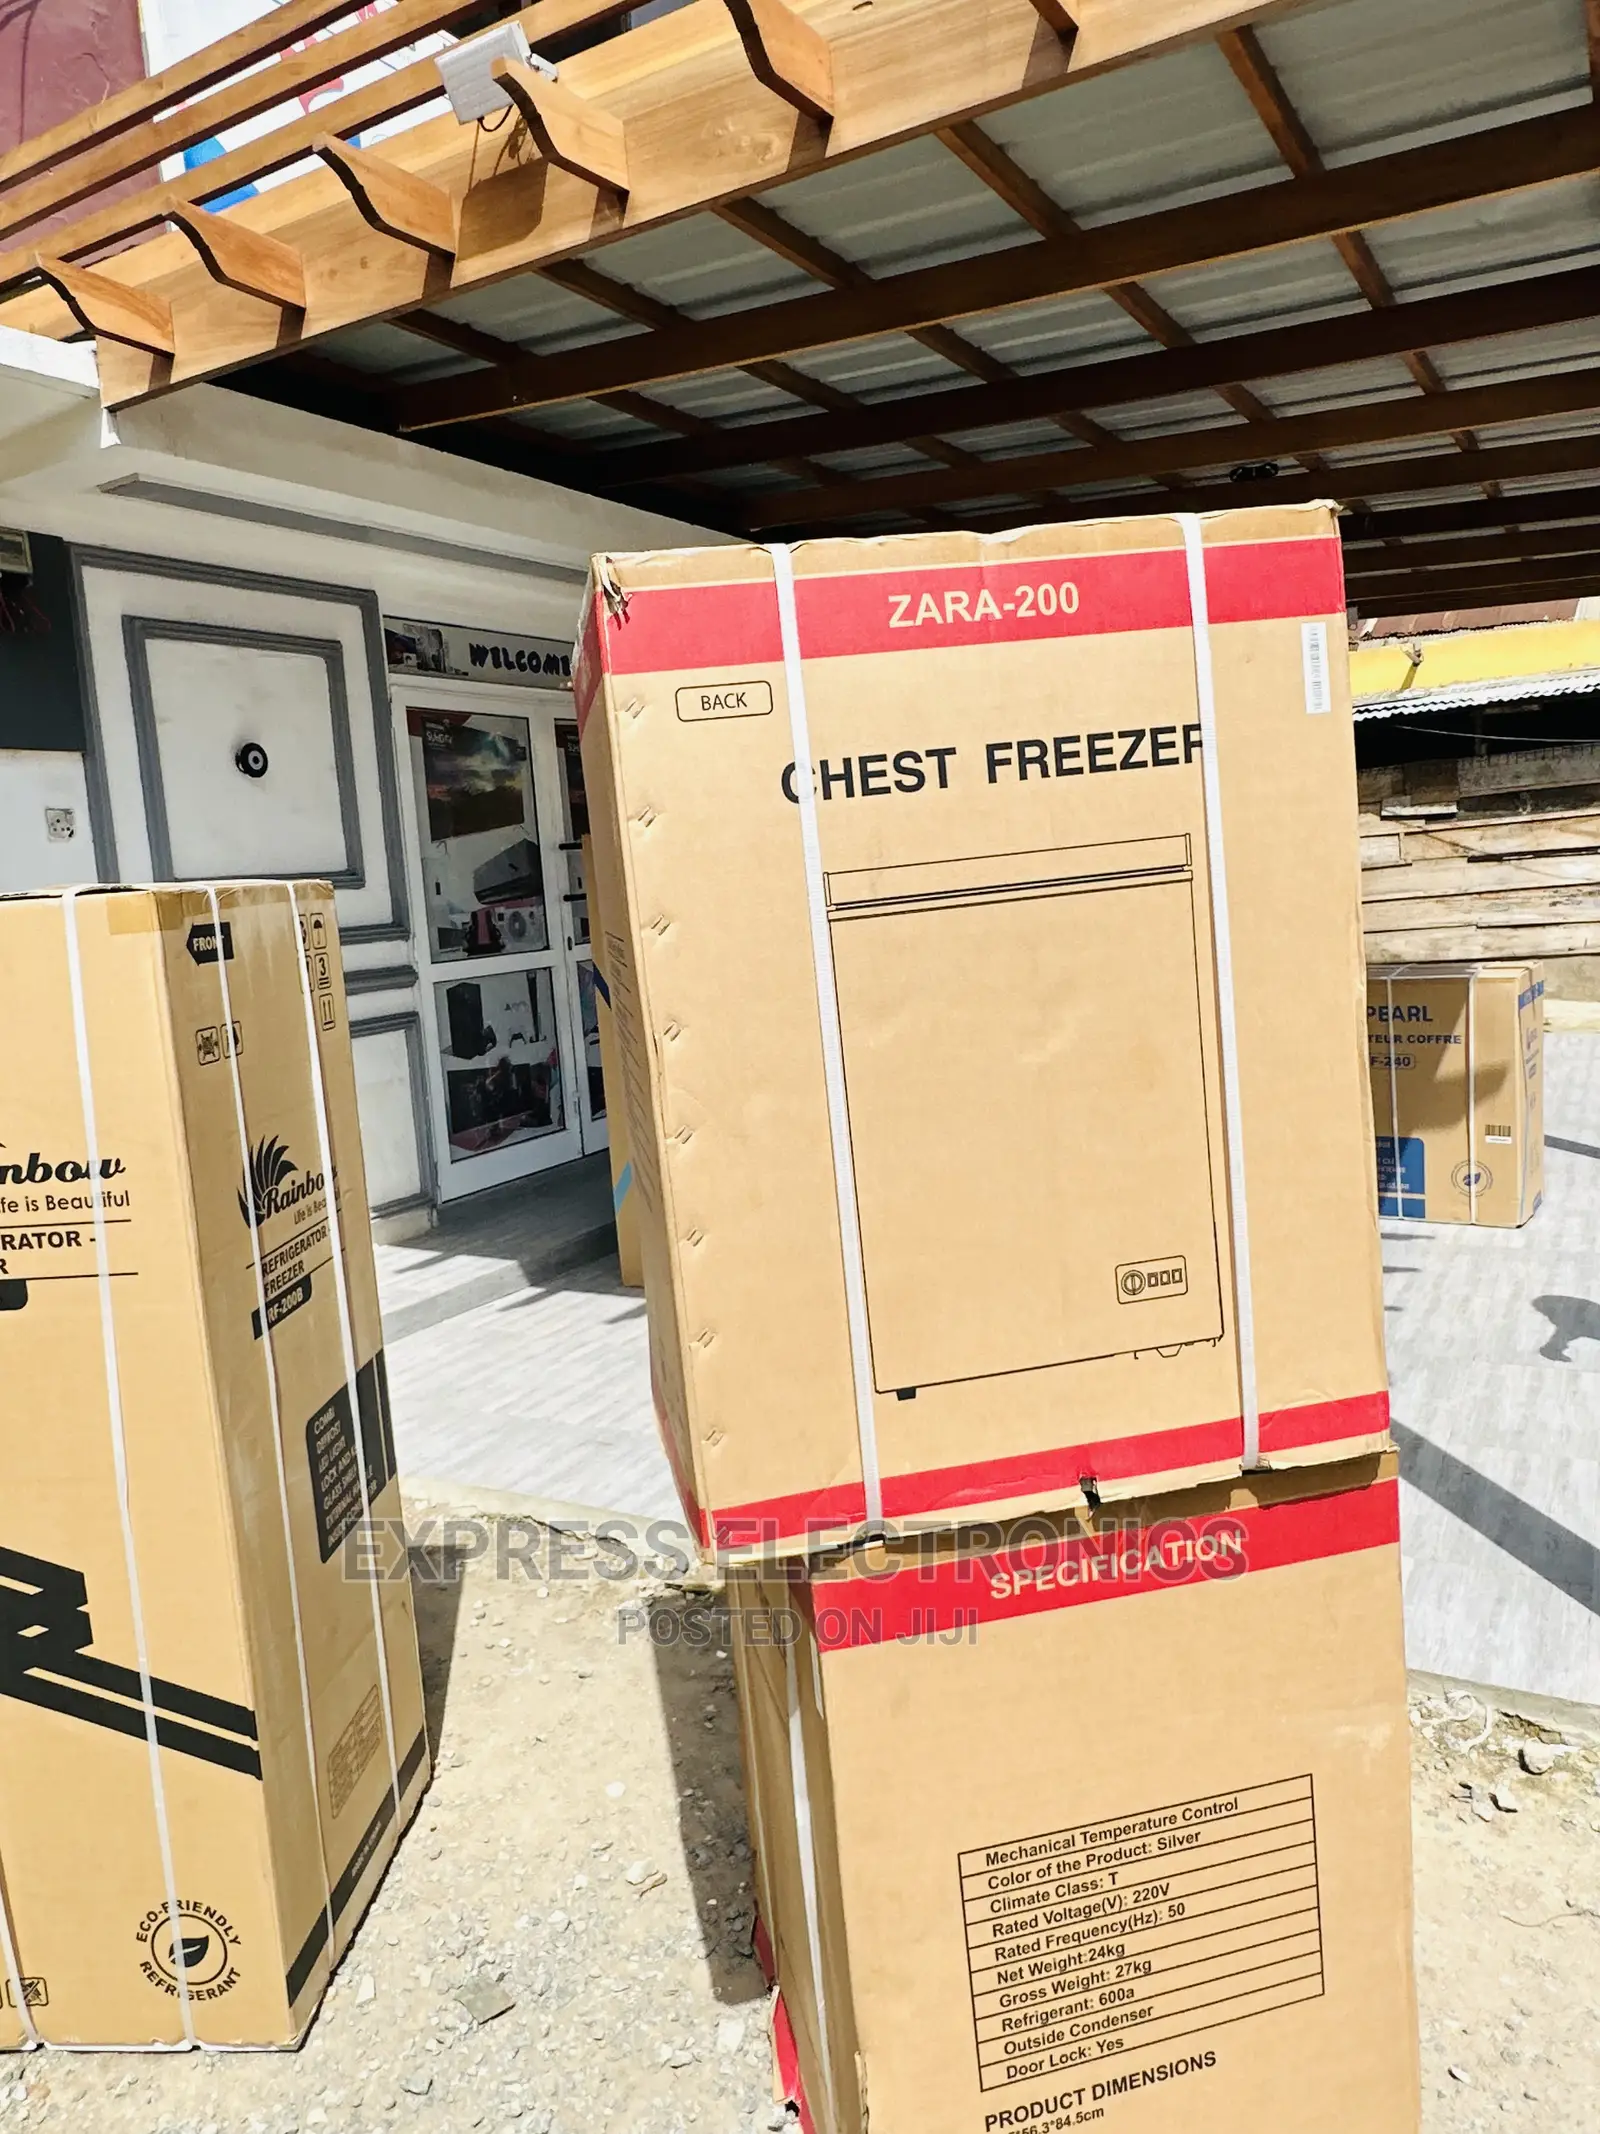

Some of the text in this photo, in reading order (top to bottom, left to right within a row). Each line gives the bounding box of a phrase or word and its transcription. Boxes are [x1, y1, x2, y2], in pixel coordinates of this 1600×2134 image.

[888, 582, 1079, 628] ZARA-200
[700, 691, 748, 712] BACK
[781, 747, 957, 804] CHEST
[192, 934, 225, 952] FRON
[1367, 1005, 1434, 1023] PEARL
[1407, 1034, 1462, 1045] COFFRE
[0, 1190, 131, 1214] fe is Beauiful
[262, 1166, 338, 1220] Rainbo
[262, 1225, 328, 1278] REFRIGERATOR
[264, 1260, 305, 1298] FREEZER
[990, 1529, 1243, 1600] SPECIFICATION
[985, 1796, 1239, 1867] Mechanical Temperature Control
[987, 1830, 1201, 1890] Color of the Product: Silver
[990, 1871, 1119, 1914] Climate Class: T
[992, 1882, 1170, 1938] Rated Voltage(V): 220V
[136, 1899, 242, 1946] ECO-FRIENDLY
[994, 1902, 1186, 1962] Rated Frequency(Hz): 50
[997, 1967, 1024, 1985] Net
[999, 1958, 1152, 2008] Gross Weight: 27kg
[1001, 1987, 1135, 2033] Refrigerant: 600a
[1003, 2005, 1154, 2055] Outside Condenser
[1006, 2036, 1125, 2080] Door Lock: Yes
[984, 2049, 1218, 2133] PRODUCT DIMENSIONS
